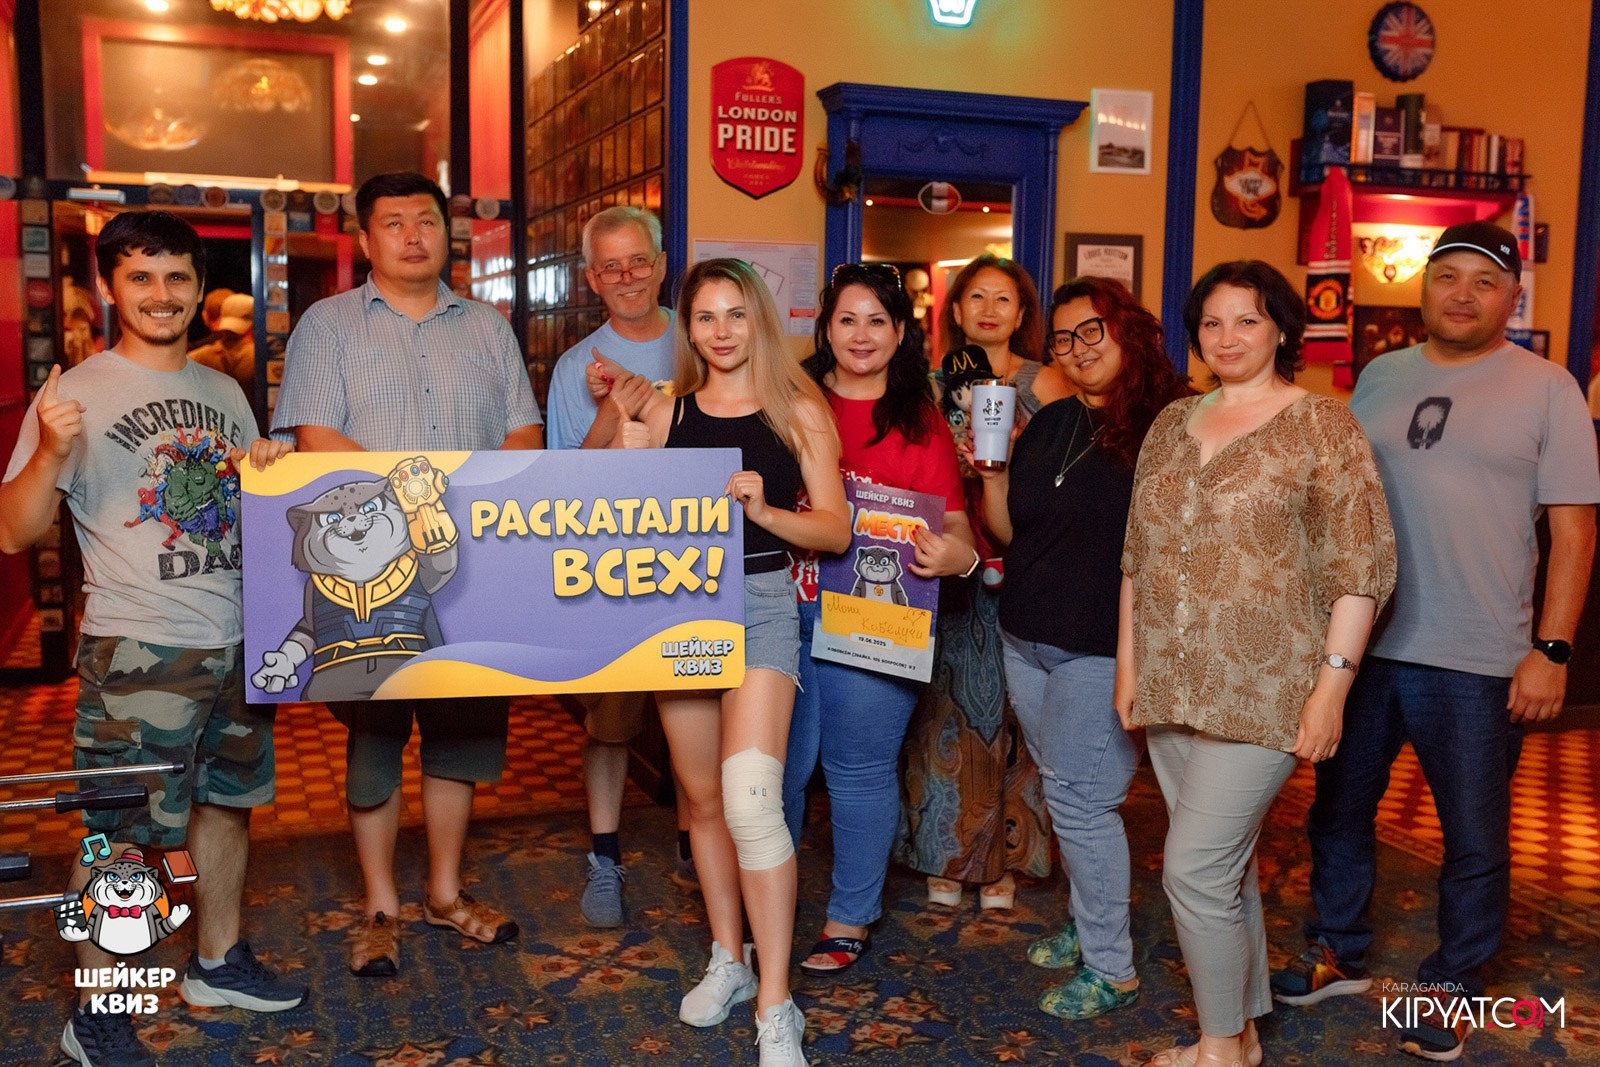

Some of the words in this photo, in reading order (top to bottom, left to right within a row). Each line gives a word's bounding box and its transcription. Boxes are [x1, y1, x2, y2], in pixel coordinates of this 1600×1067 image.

[717, 105, 797, 123] LONDON
[717, 123, 796, 153] PRIDE
[104, 398, 241, 454] INCREDIBLE
[856, 490, 889, 503] ШЕЙКЕР
[891, 497, 915, 508] КВИЗ
[471, 496, 730, 538] РАСКАТАЛИ
[158, 544, 241, 580] DA
[553, 546, 726, 598] ВСЕХ!
[661, 637, 734, 658] ШЕЙКЕР
[673, 658, 723, 677] КВИЗ
